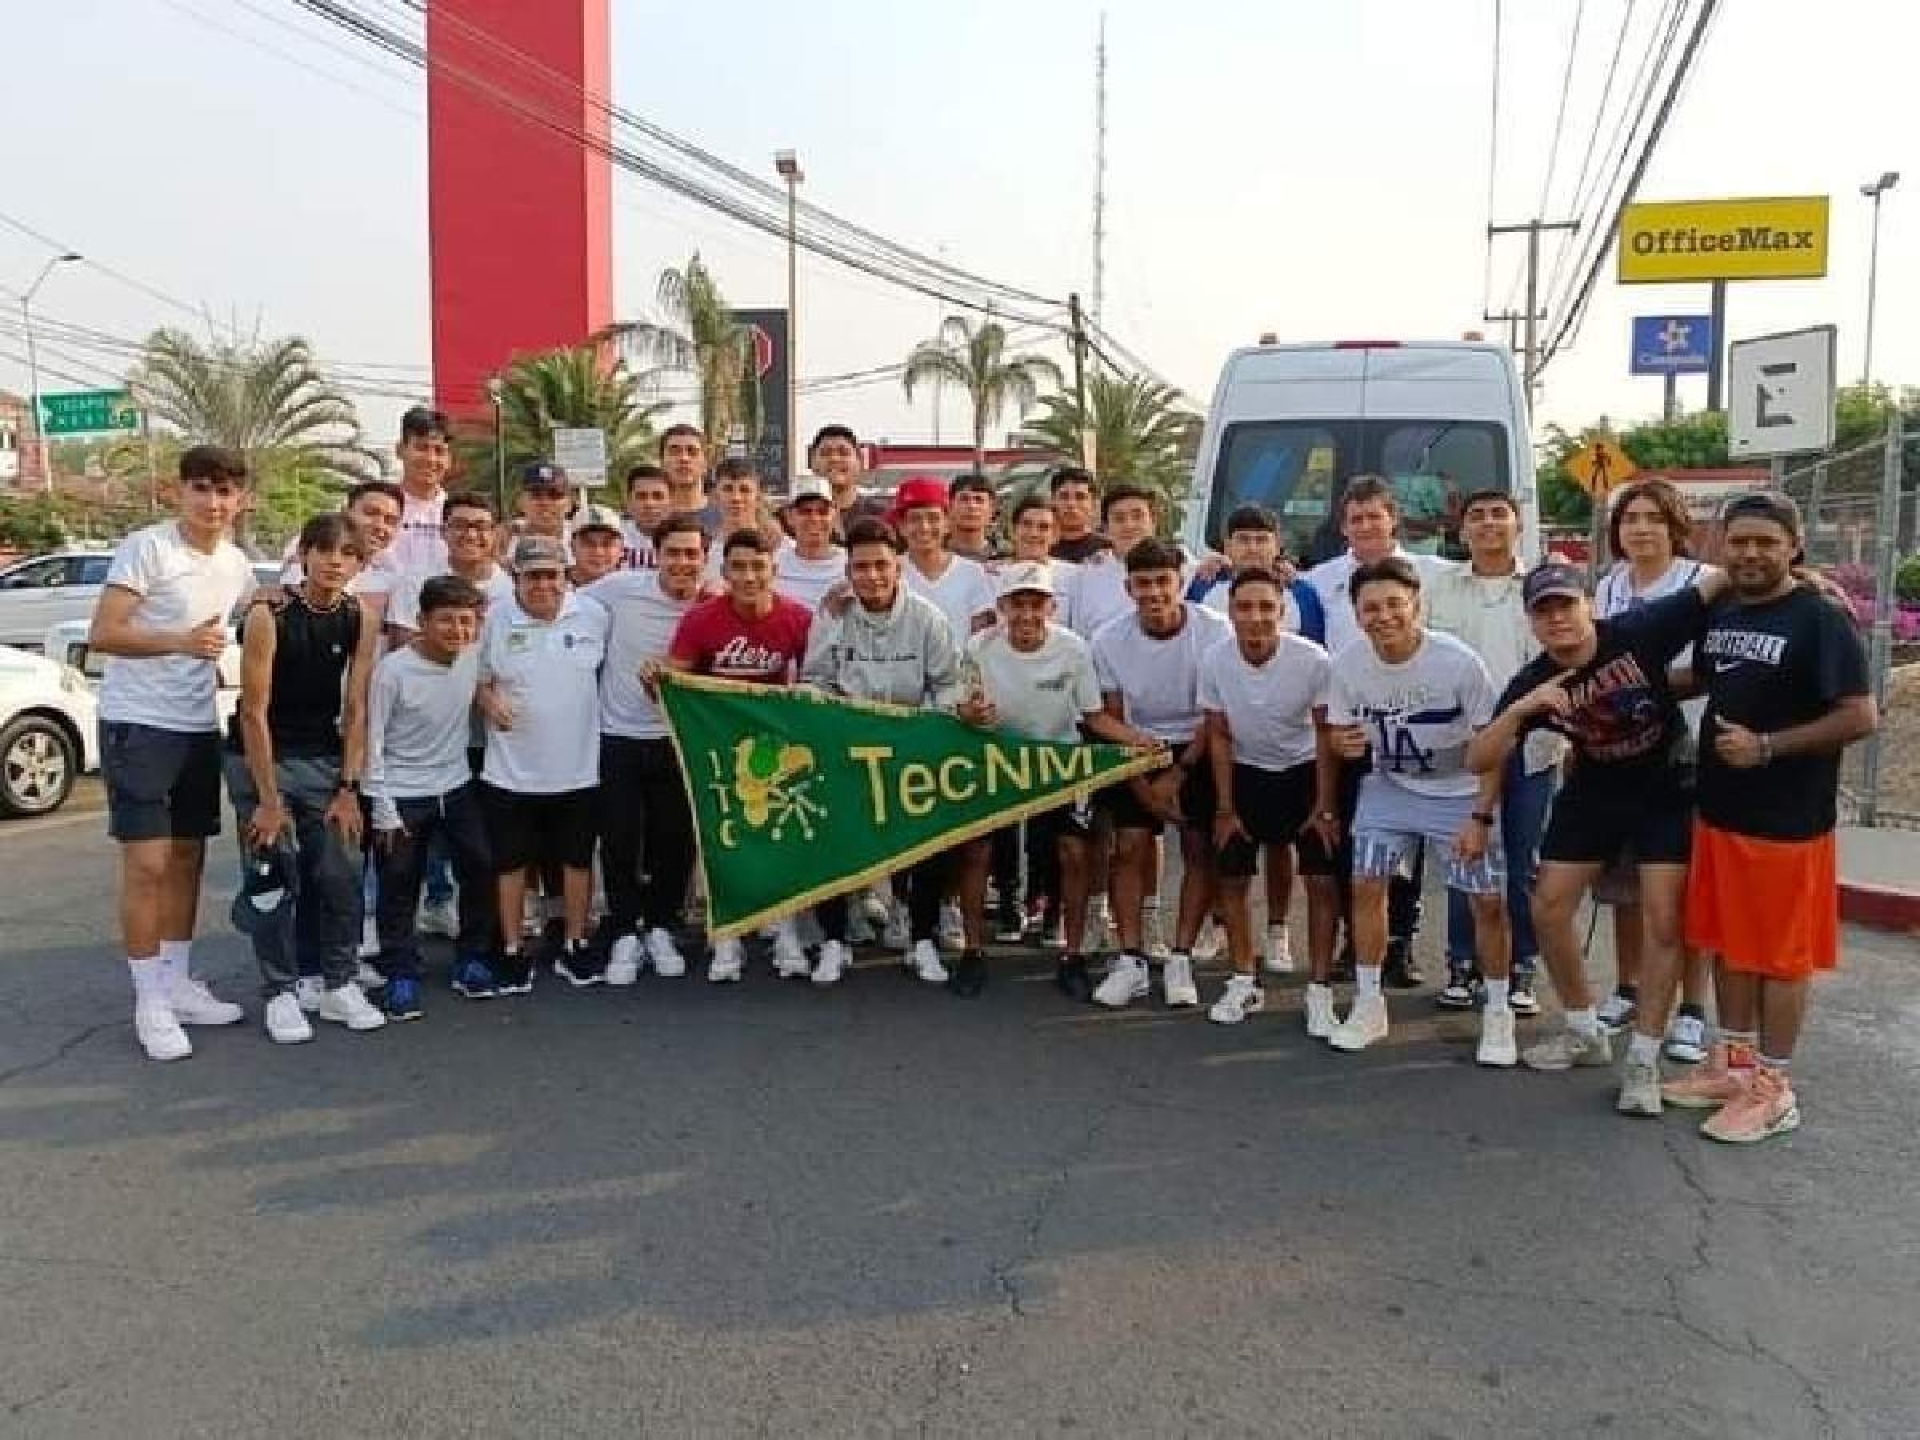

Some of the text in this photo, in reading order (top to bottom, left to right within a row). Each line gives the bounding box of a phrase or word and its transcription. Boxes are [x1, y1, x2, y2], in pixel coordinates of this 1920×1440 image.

[1631, 227, 1814, 254] OfficeMax
[1370, 711, 1437, 773] LA
[848, 742, 1093, 825] TecNM
